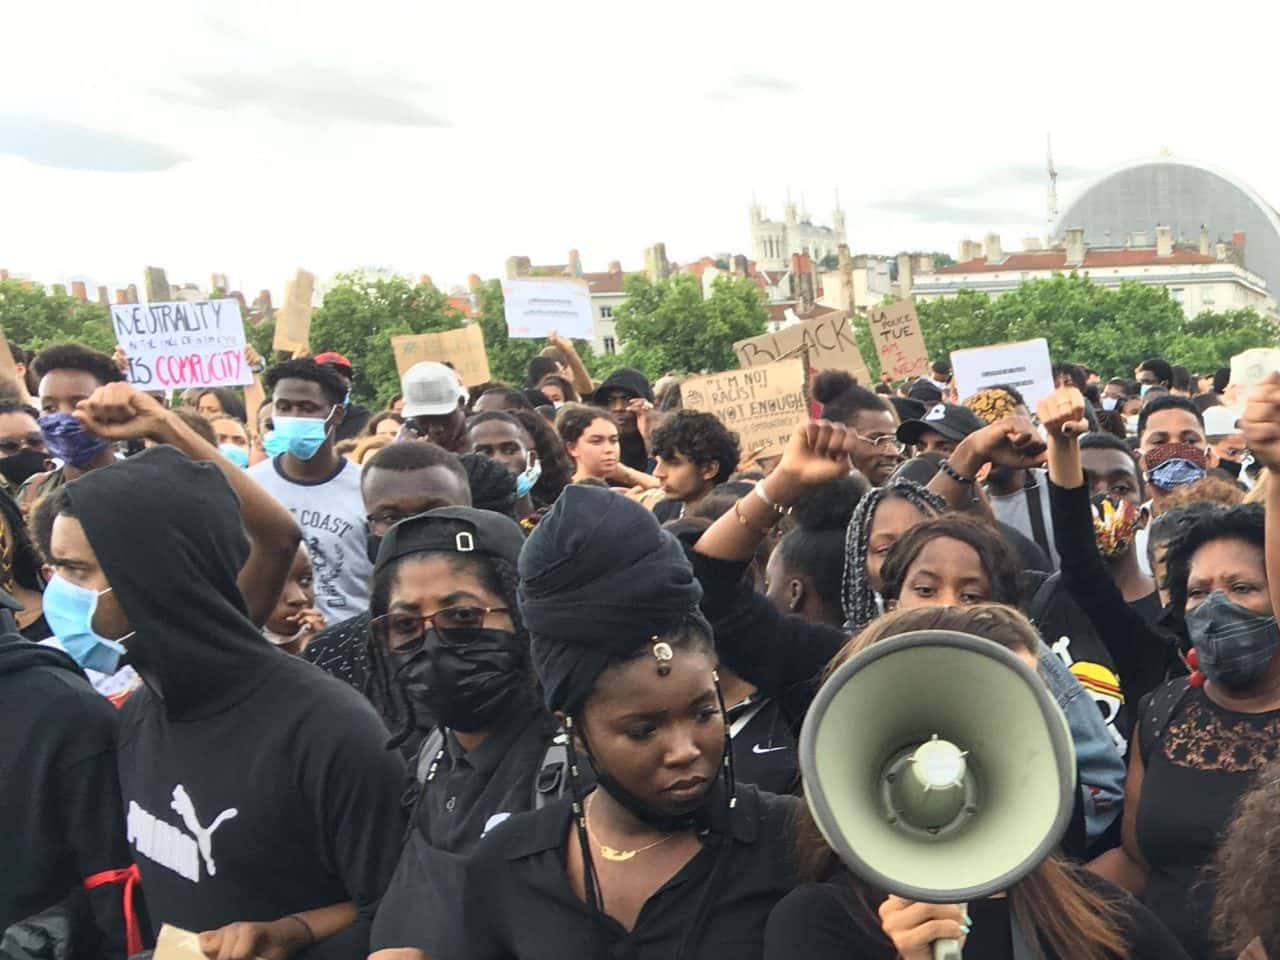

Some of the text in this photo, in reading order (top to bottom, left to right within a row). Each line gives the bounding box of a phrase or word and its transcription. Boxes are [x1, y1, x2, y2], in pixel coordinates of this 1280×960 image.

[115, 302, 222, 336] NEUTRALITY
[880, 326, 914, 342] TUE
[128, 349, 242, 387] IS COMPLICITY
[743, 369, 768, 386] NOT
[750, 391, 805, 417] ENOUGH
[300, 509, 354, 539] COAST
